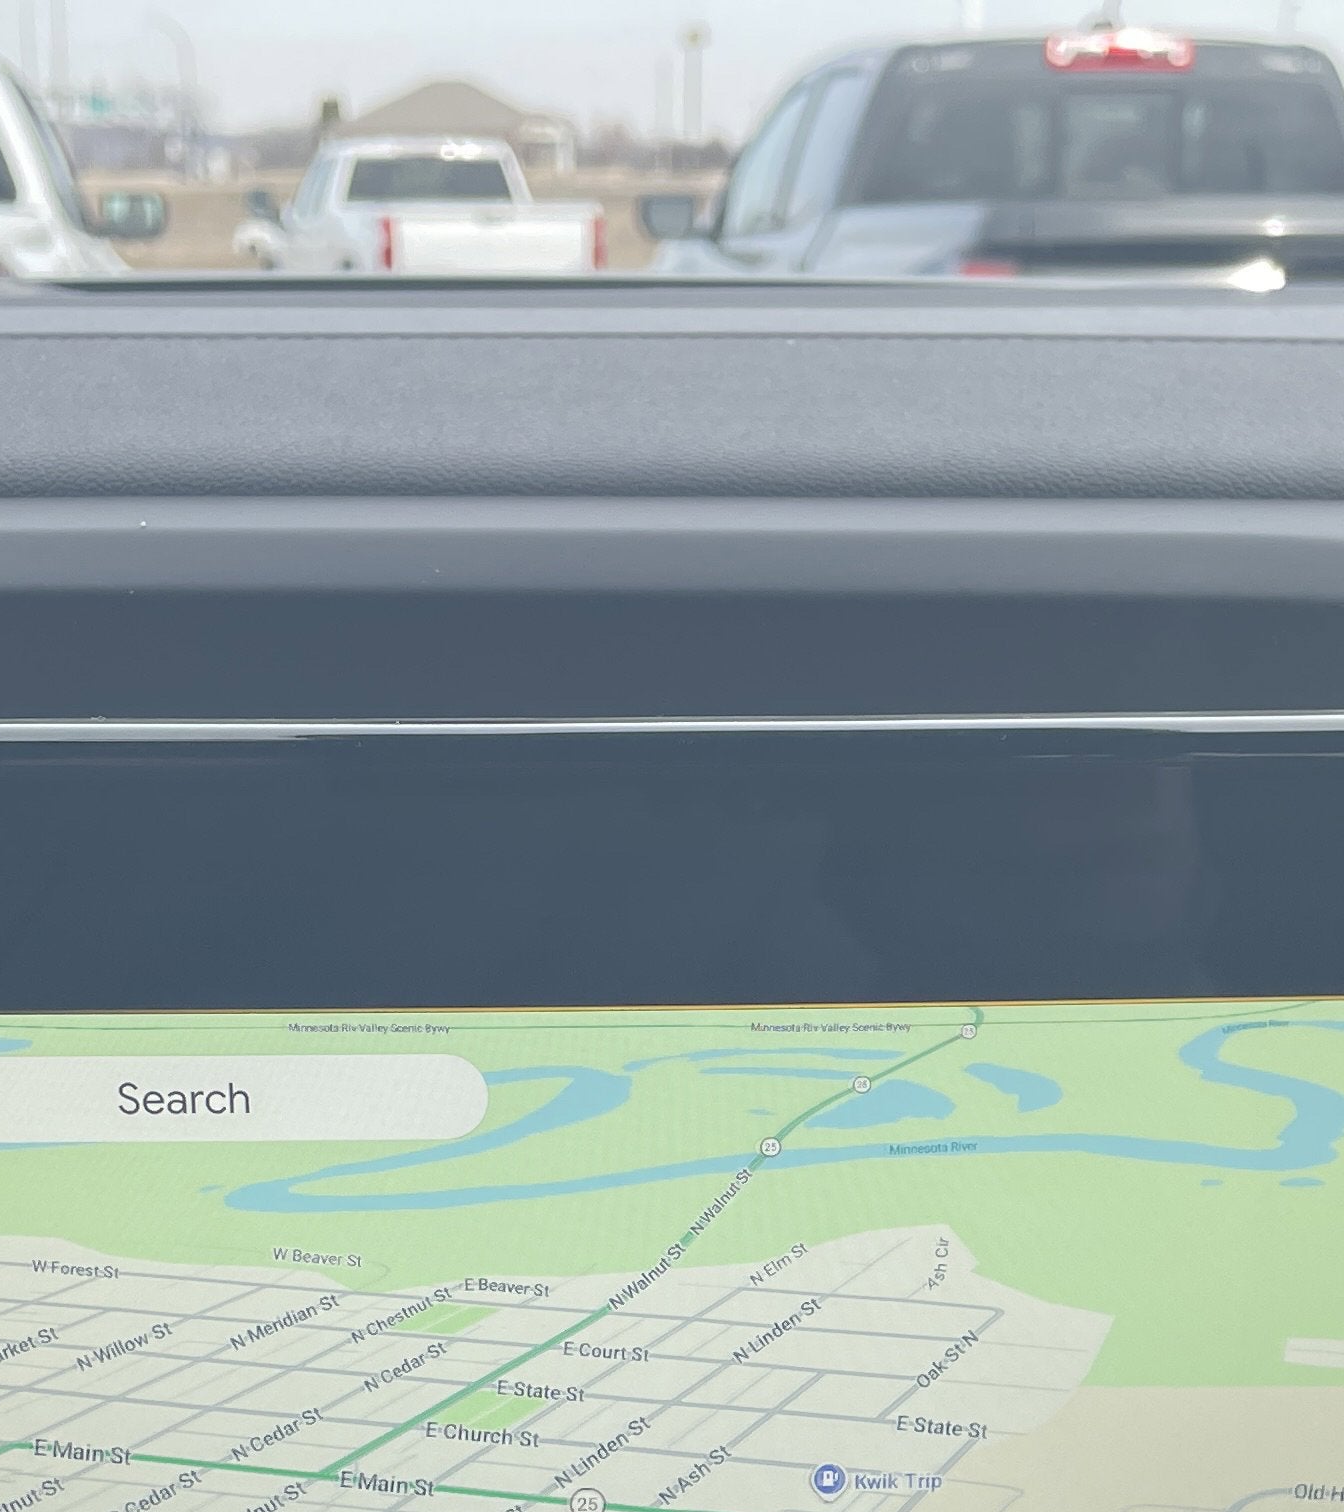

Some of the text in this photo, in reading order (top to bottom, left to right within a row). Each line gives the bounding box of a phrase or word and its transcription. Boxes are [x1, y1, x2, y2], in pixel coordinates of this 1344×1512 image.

[118, 1082, 251, 1116] Search
[764, 1142, 777, 1151] 25
[889, 1141, 978, 1156] Minnesota River
[690, 1168, 753, 1236] N Walnut St
[32, 1259, 119, 1280] W Forest St
[273, 1247, 362, 1269] W Beaver St
[749, 1242, 809, 1287] N Elm St
[464, 1277, 550, 1298] E Beaver St
[608, 1243, 686, 1311] N Walnut St
[927, 1262, 948, 1290] Ash
[230, 1334, 247, 1351] N
[319, 1294, 341, 1312] St
[351, 1286, 453, 1345] N Chestnut St
[38, 1326, 60, 1345] St
[732, 1297, 822, 1365] N Linden St
[76, 1321, 174, 1372] N Willow St
[563, 1341, 650, 1363] E Court St
[916, 1330, 979, 1389] Oak St N
[364, 1341, 448, 1393] N Cedar St
[497, 1379, 585, 1403] E State St
[230, 1406, 324, 1463] N Cedar St
[425, 1421, 539, 1448] E Church St
[896, 1415, 988, 1440] E State St
[34, 1438, 132, 1465] E Main St
[554, 1415, 651, 1490] N Linden St
[41, 1477, 65, 1498] St
[178, 1469, 202, 1490] St
[340, 1470, 435, 1497] E Main St
[659, 1445, 733, 1506] N Ash St
[855, 1472, 943, 1492] Kwik Trip
[284, 1481, 308, 1502] St
[577, 1497, 598, 1512] 25
[1294, 1483, 1326, 1501] Old
